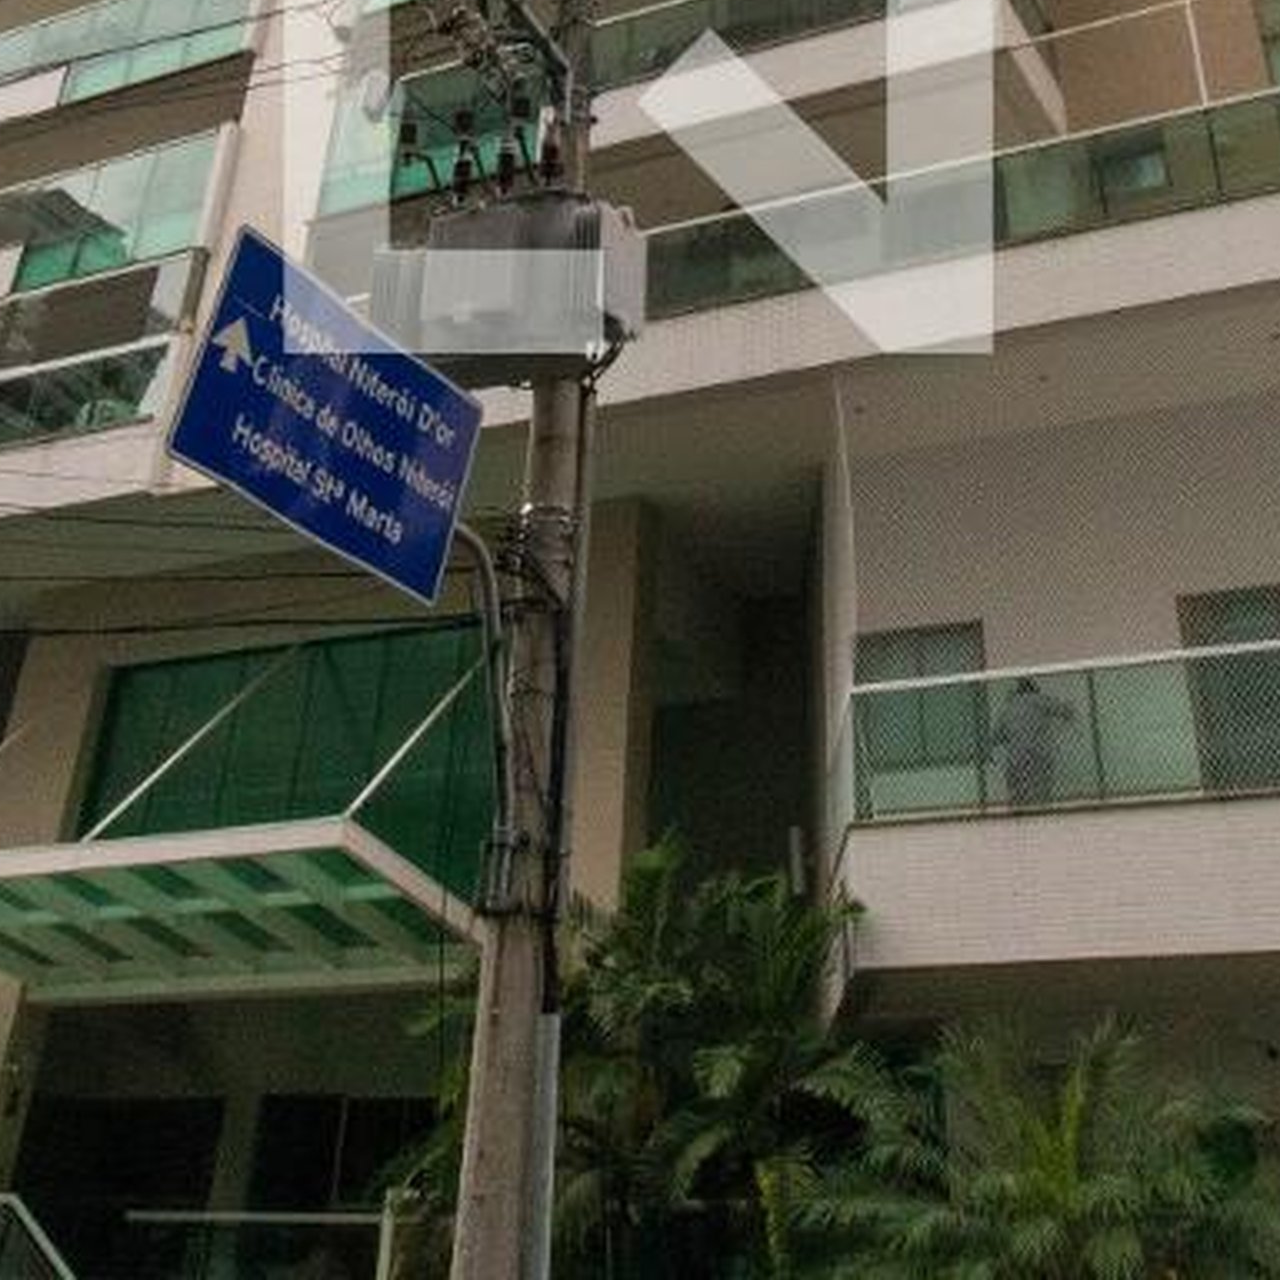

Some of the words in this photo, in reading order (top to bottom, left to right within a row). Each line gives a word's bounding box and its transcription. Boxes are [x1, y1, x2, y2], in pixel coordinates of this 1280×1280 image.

[251, 354, 316, 420] Clínica
[316, 404, 339, 438] de
[342, 422, 395, 474] Olhos
[270, 294, 349, 373] Hospital
[348, 357, 416, 422] Niterói
[417, 402, 456, 448] D'or
[231, 412, 312, 484] Hospital
[345, 488, 404, 545] Maria
